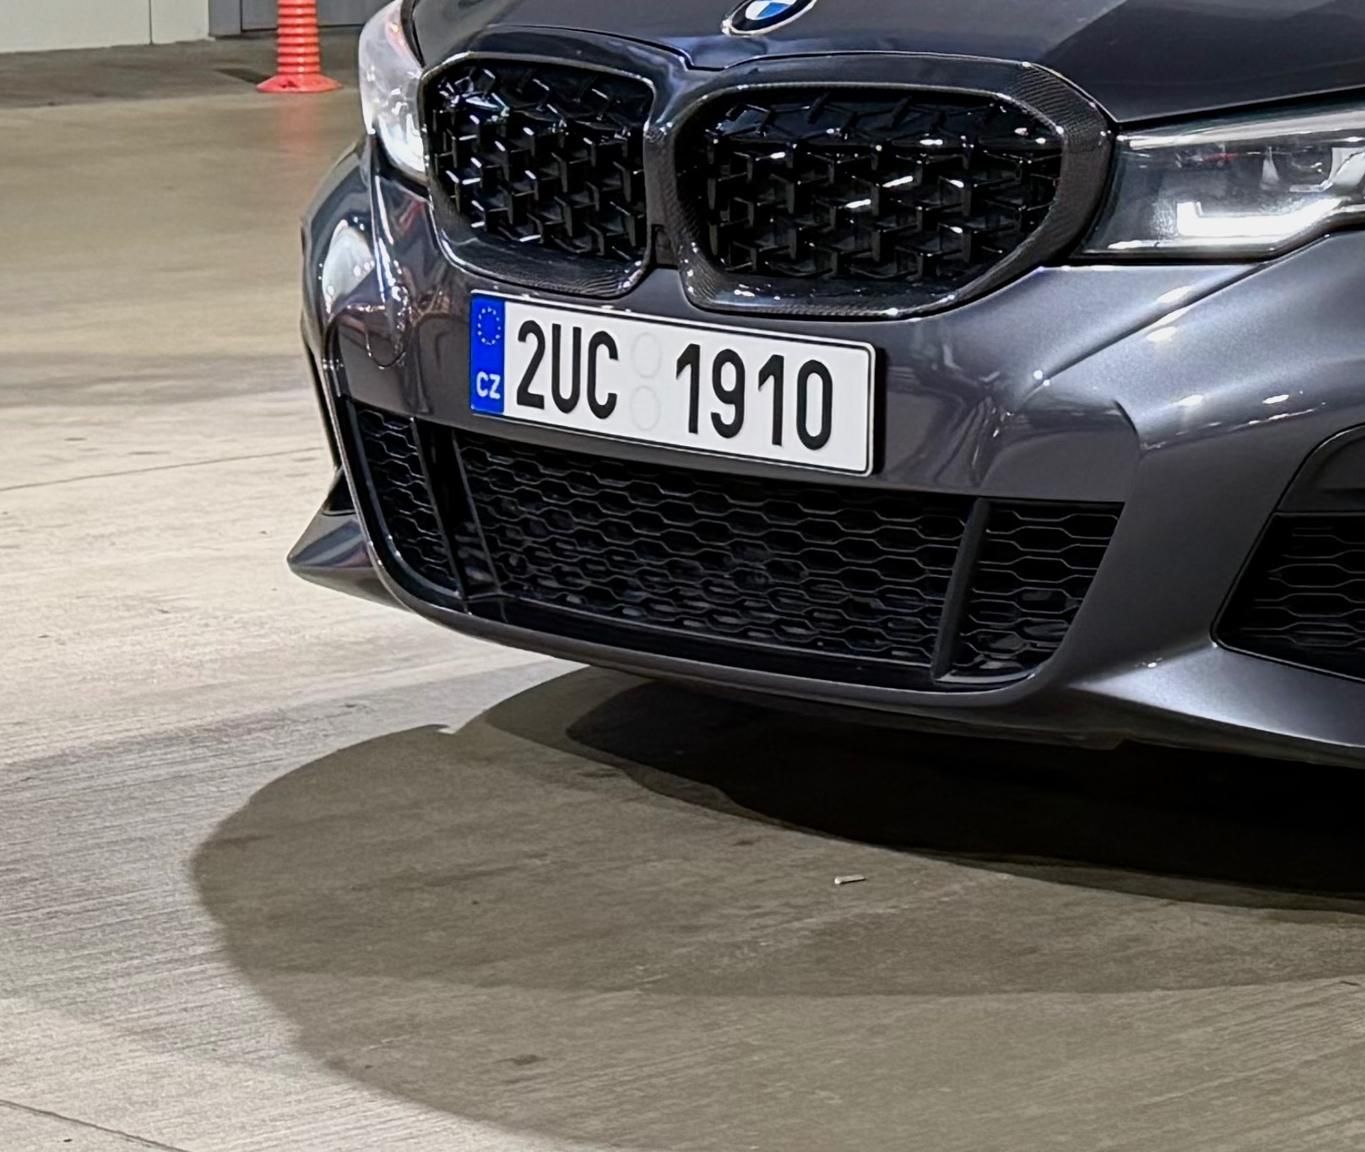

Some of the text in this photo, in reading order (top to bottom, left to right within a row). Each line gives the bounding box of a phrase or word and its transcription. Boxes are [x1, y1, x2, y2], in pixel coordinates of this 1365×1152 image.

[476, 371, 501, 400] CZ
[516, 319, 833, 452] 2UC 1910
